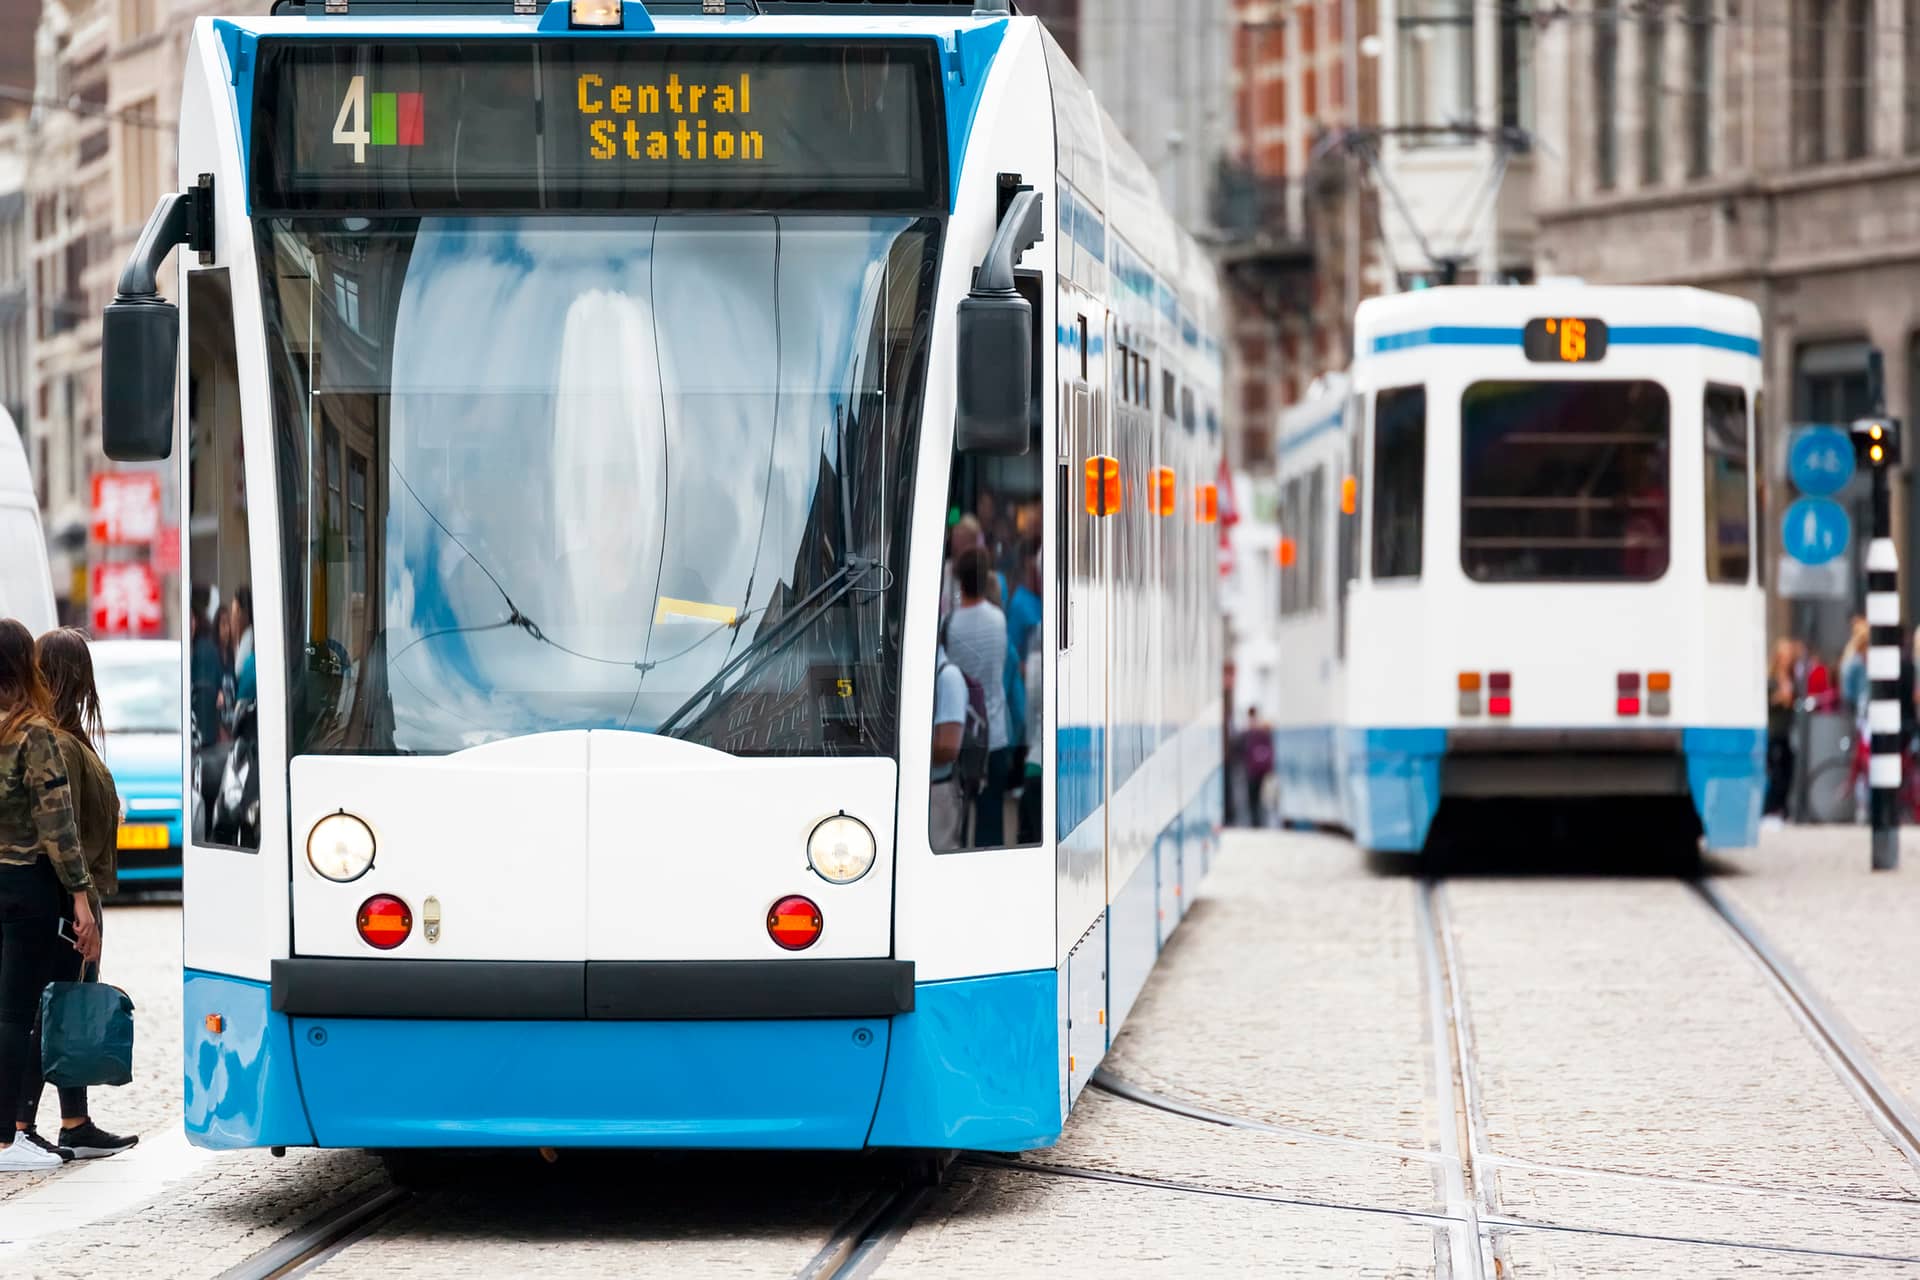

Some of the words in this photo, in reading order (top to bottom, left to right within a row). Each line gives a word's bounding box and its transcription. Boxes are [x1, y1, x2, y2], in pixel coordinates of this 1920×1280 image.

[578, 73, 750, 114] Central
[332, 75, 370, 163] 4
[590, 119, 763, 160] Station
[837, 679, 852, 697] 5
